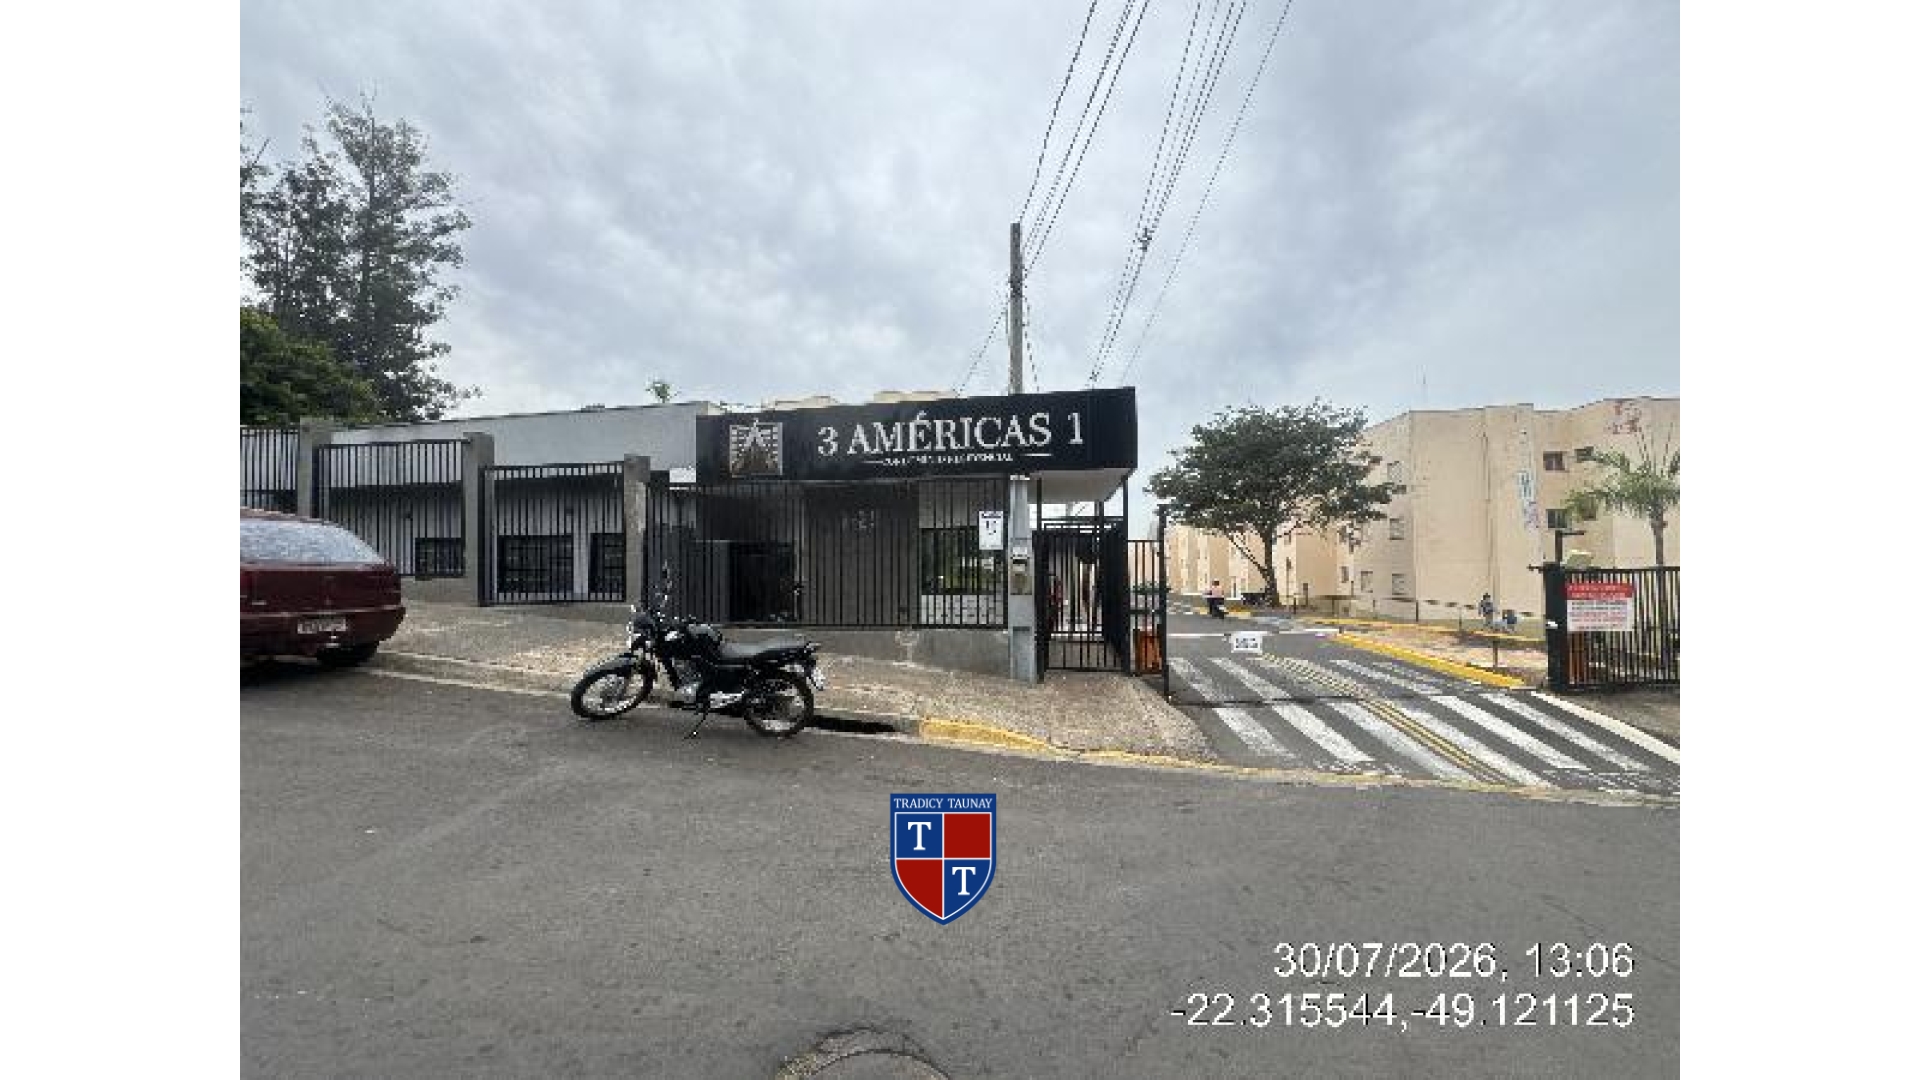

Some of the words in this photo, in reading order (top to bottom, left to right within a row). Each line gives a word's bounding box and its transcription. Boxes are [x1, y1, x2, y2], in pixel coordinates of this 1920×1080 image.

[818, 426, 838, 456] 3
[847, 410, 1052, 455] AMÉRICAS
[1068, 413, 1084, 446] 1
